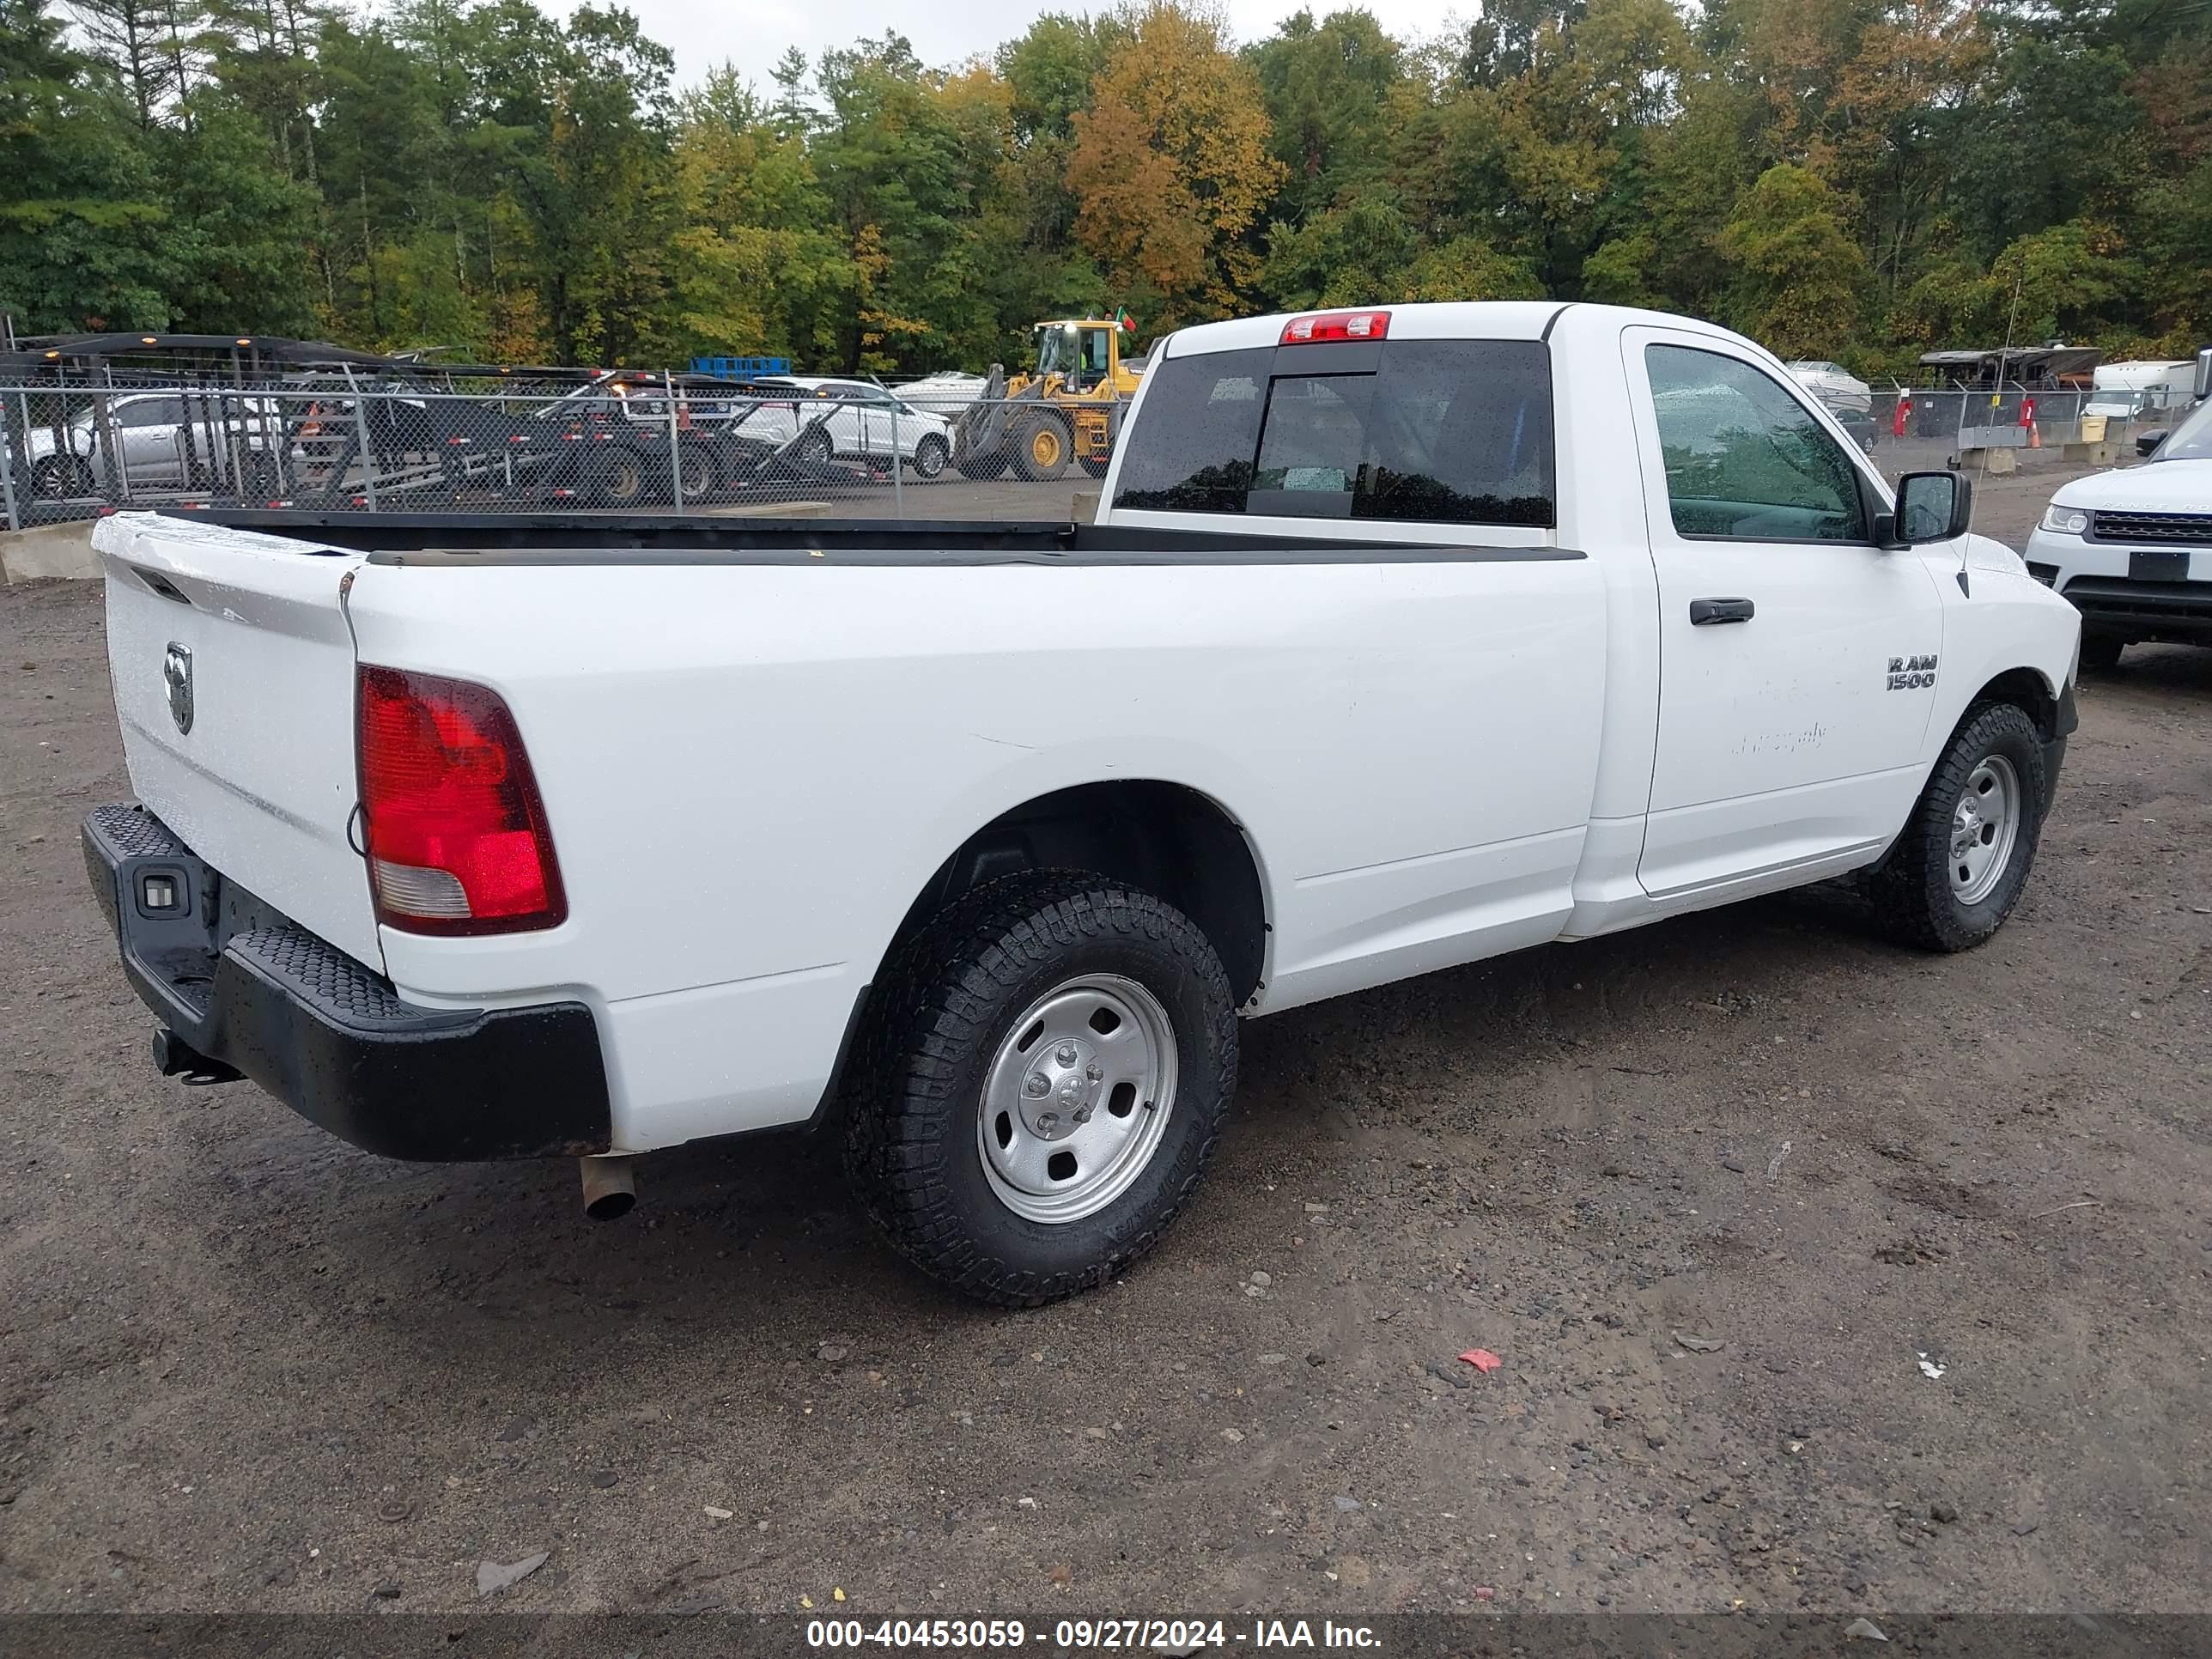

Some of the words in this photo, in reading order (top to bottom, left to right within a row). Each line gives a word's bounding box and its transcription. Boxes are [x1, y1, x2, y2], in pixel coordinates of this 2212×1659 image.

[2101, 501, 2169, 510] RANGE
[1887, 654, 1938, 673] RAM
[1886, 672, 1936, 690] 1500
